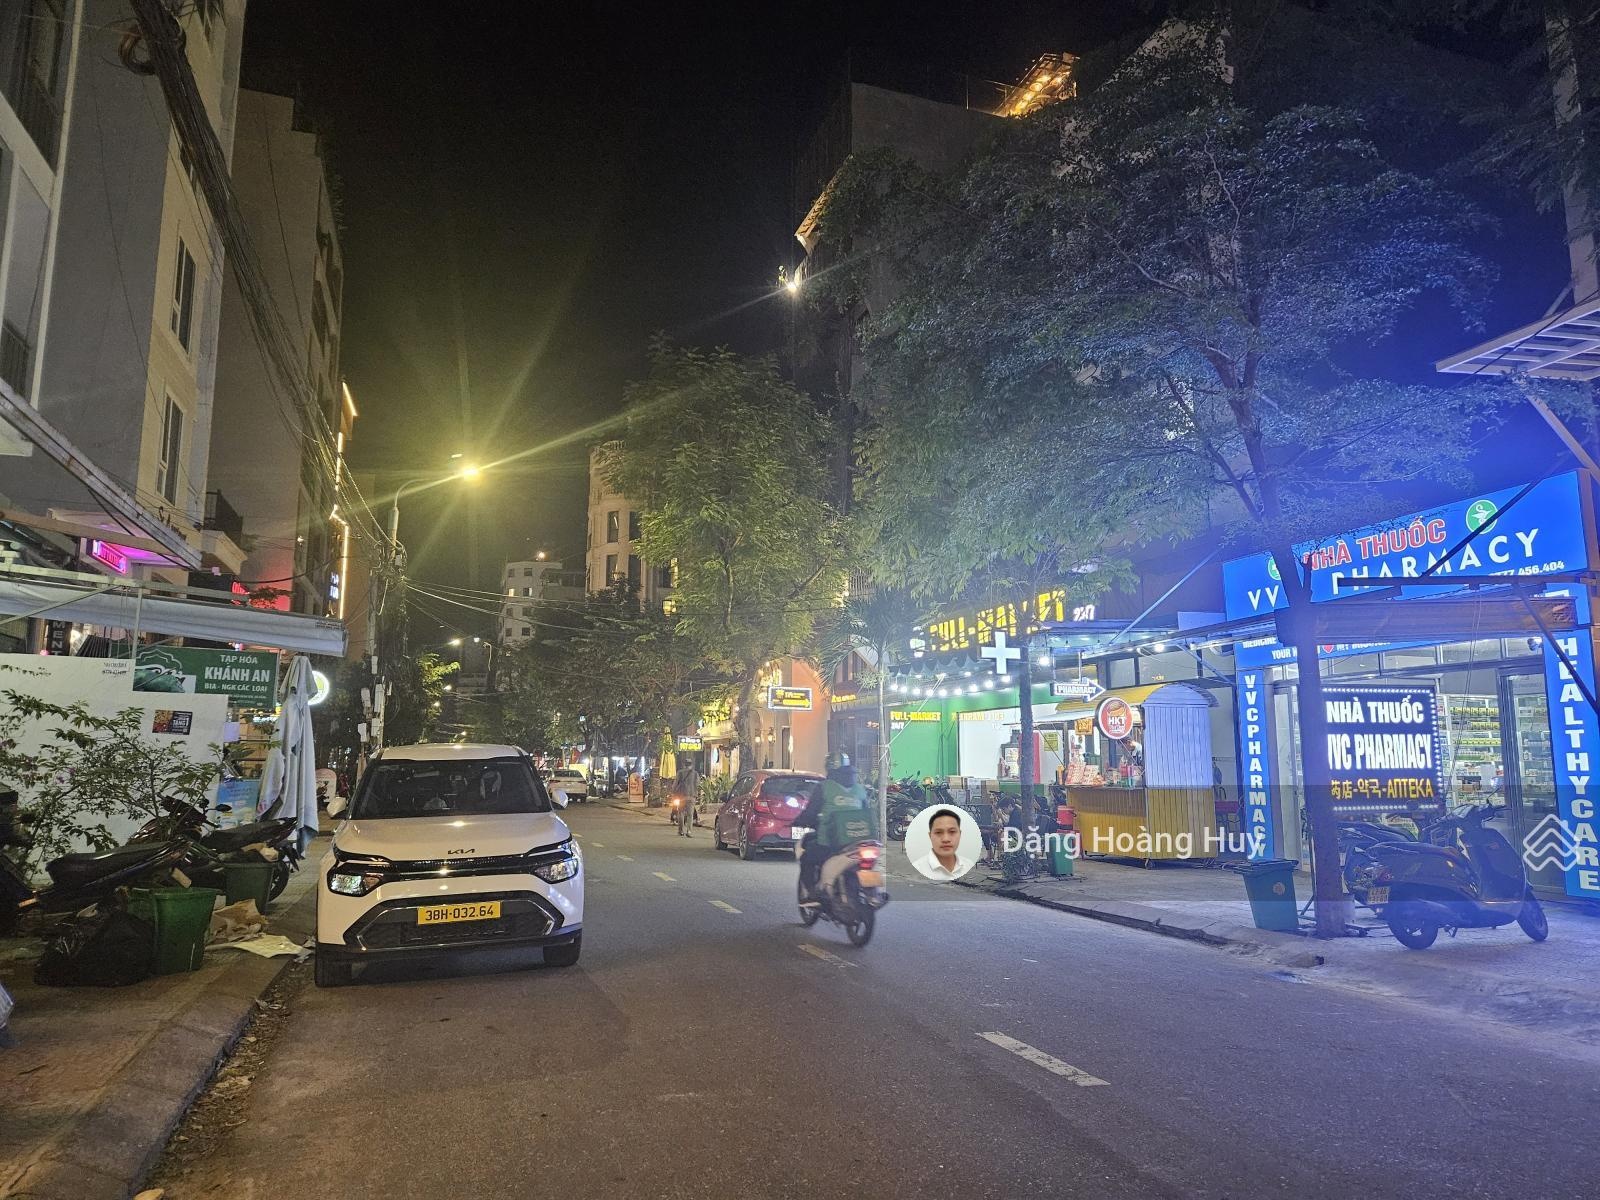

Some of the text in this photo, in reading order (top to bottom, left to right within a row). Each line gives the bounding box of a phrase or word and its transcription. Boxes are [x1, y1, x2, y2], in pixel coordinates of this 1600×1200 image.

[1356, 515, 1446, 560] THUỐC
[204, 666, 270, 682] KHÁNH AN
[1056, 685, 1096, 694] PHARMACY
[1326, 694, 1425, 724] NHÀ THUỐC
[1108, 715, 1127, 726] HKT
[1353, 733, 1433, 770] PHARMACY
[425, 905, 494, 920] 38H-032.64
